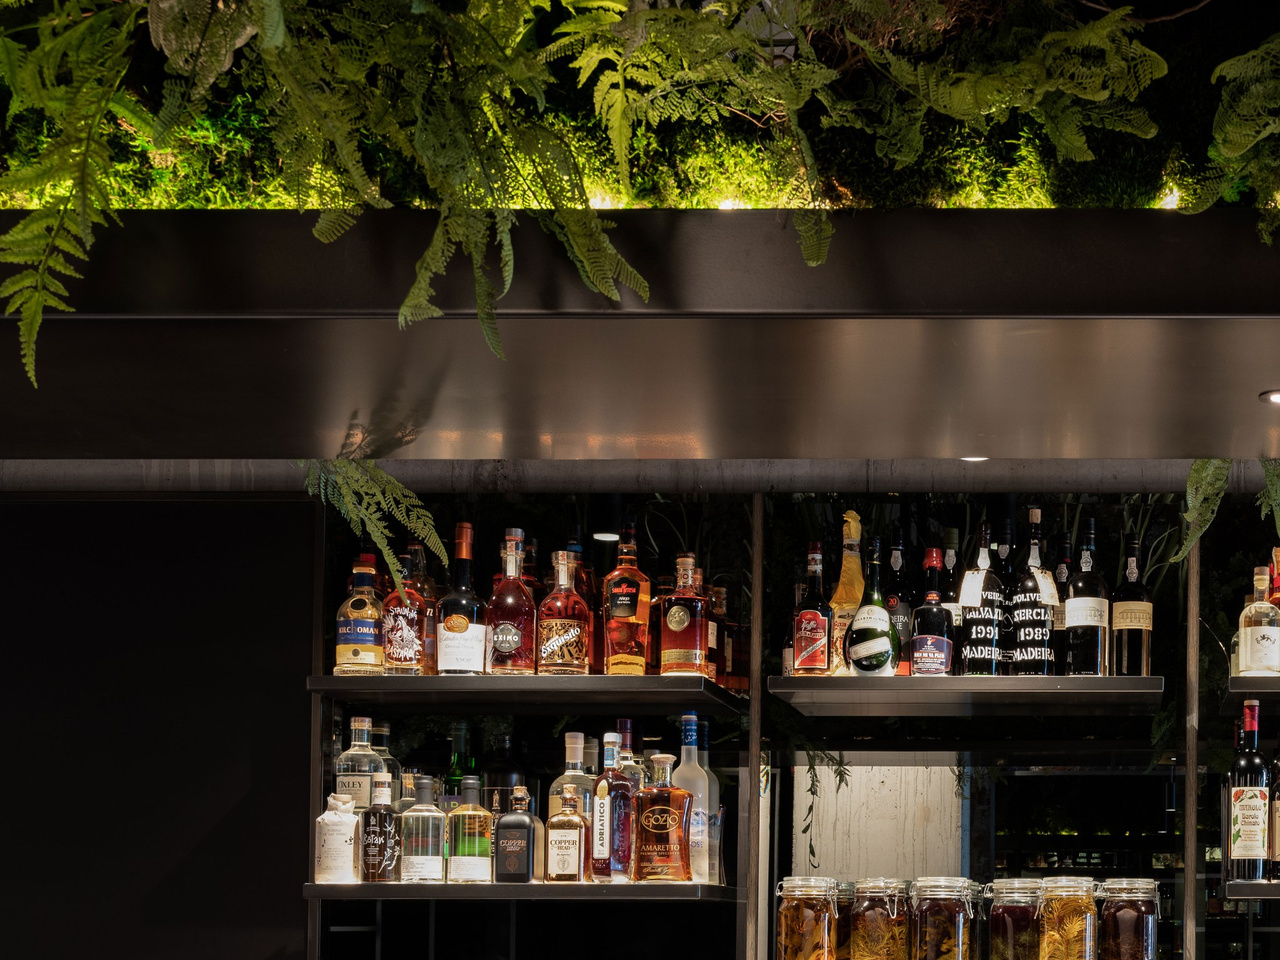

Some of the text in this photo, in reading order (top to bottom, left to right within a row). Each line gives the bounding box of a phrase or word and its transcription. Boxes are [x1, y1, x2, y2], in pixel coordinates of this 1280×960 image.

[493, 634, 519, 642] EXIMO
[971, 625, 999, 639] 1991
[1018, 627, 1050, 641] 1989
[1012, 646, 1055, 662] MADEIRA
[598, 801, 606, 848] ADRIATICO
